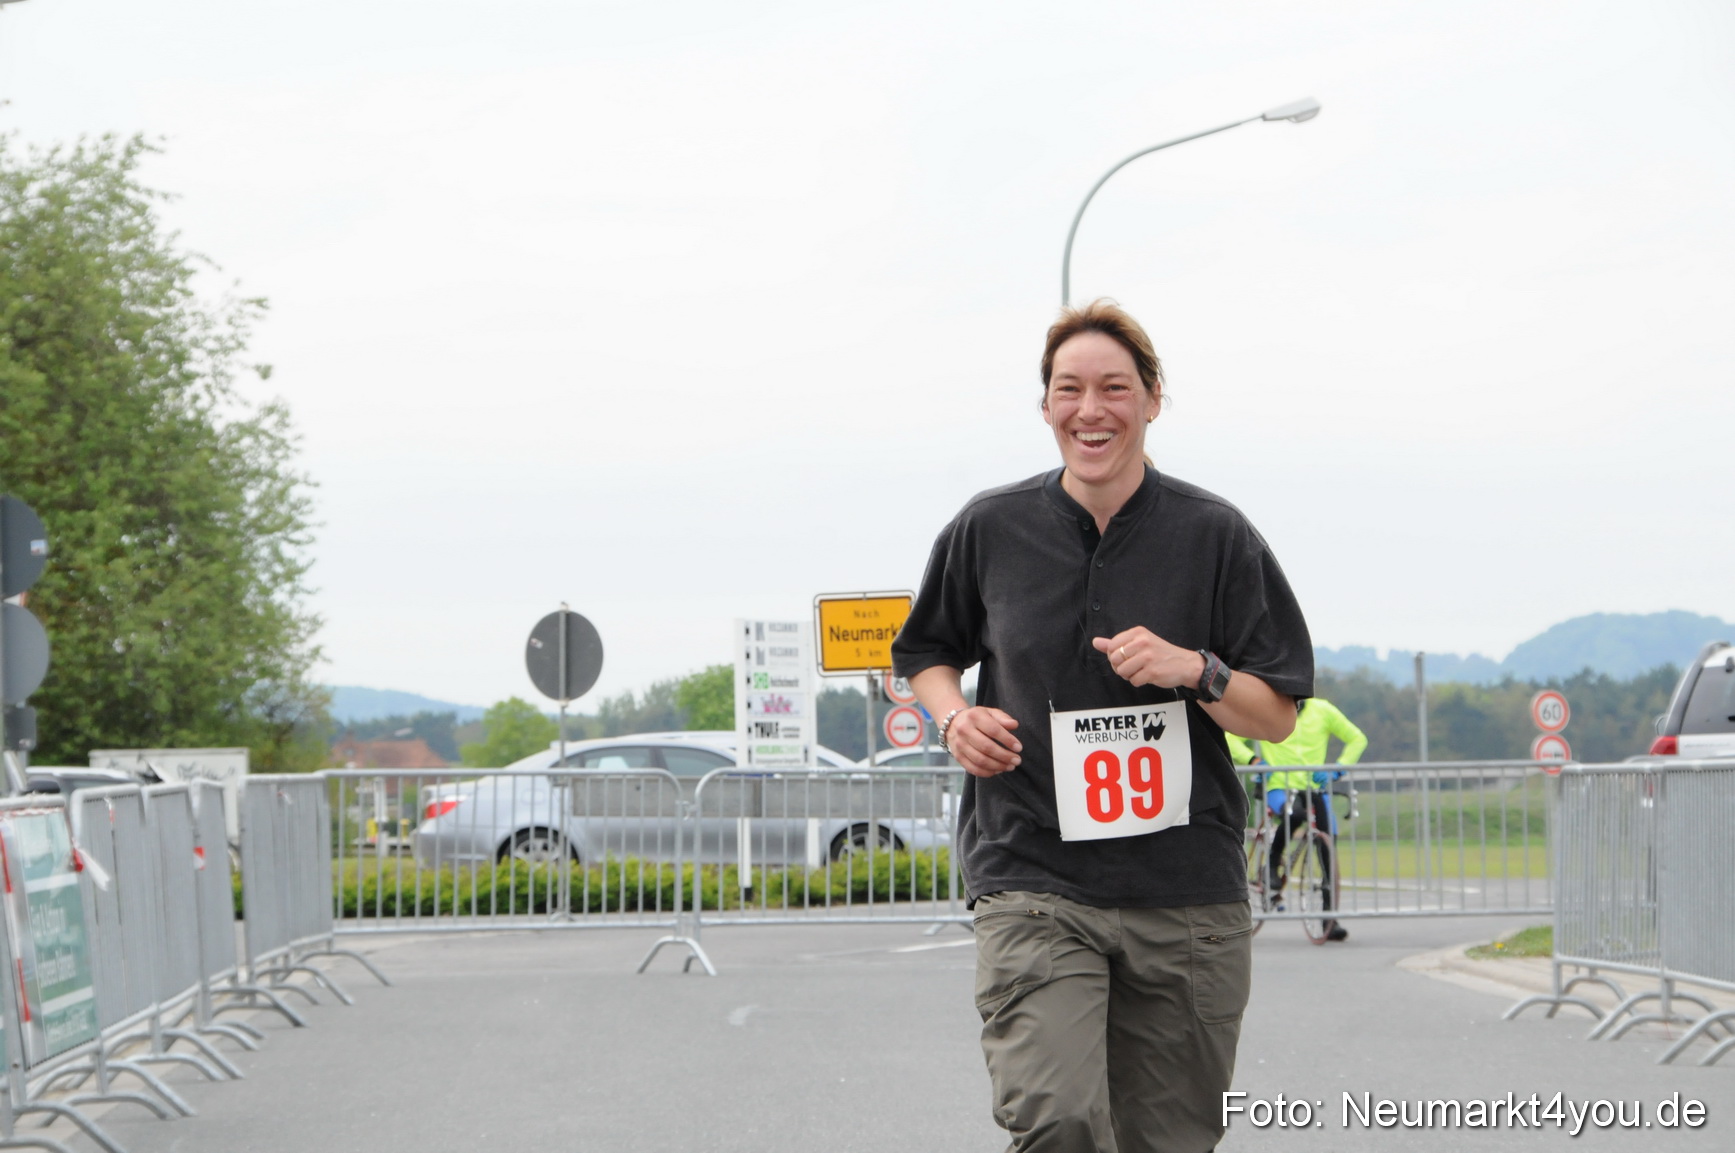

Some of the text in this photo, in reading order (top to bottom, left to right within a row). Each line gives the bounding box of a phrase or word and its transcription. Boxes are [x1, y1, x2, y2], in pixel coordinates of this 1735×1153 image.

[853, 609, 880, 619] Nach
[869, 648, 882, 657] km
[1542, 703, 1561, 721] 60
[1074, 714, 1137, 733] MEYER
[1075, 730, 1139, 744] WERBUNG
[1083, 746, 1165, 823] 89
